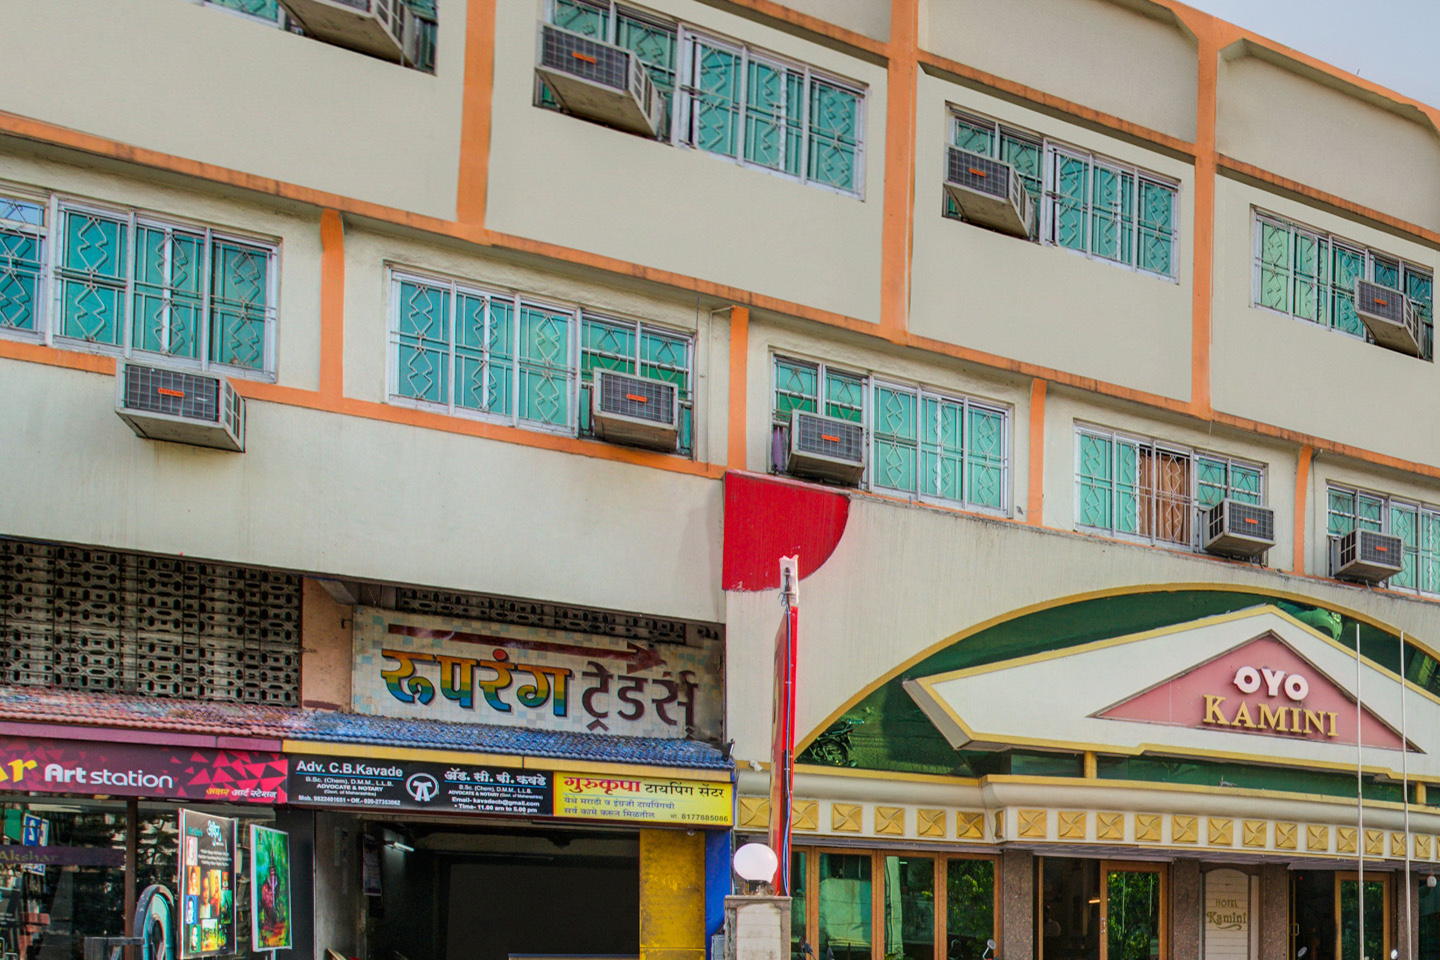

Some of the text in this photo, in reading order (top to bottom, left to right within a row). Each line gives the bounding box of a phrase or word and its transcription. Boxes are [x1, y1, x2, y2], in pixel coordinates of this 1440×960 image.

[381, 648, 575, 718] रूपरंग
[1233, 665, 1309, 701] OYO
[1202, 694, 1339, 737] KAMINI
[44, 763, 87, 785] Art
[90, 769, 174, 789] station
[296, 761, 404, 777] Adv. C.B.Kavade
[473, 770, 494, 783] सी.
[516, 773, 547, 786] कवडे
[231, 787, 250, 797] आर्ट
[251, 788, 278, 798] स्टेशन
[564, 776, 724, 798] गुरुकृपा टायपिंग सेंटर
[681, 813, 729, 822] 8177885086
[1215, 899, 1238, 908] HOTEL
[1206, 911, 1248, 930] Kamini
